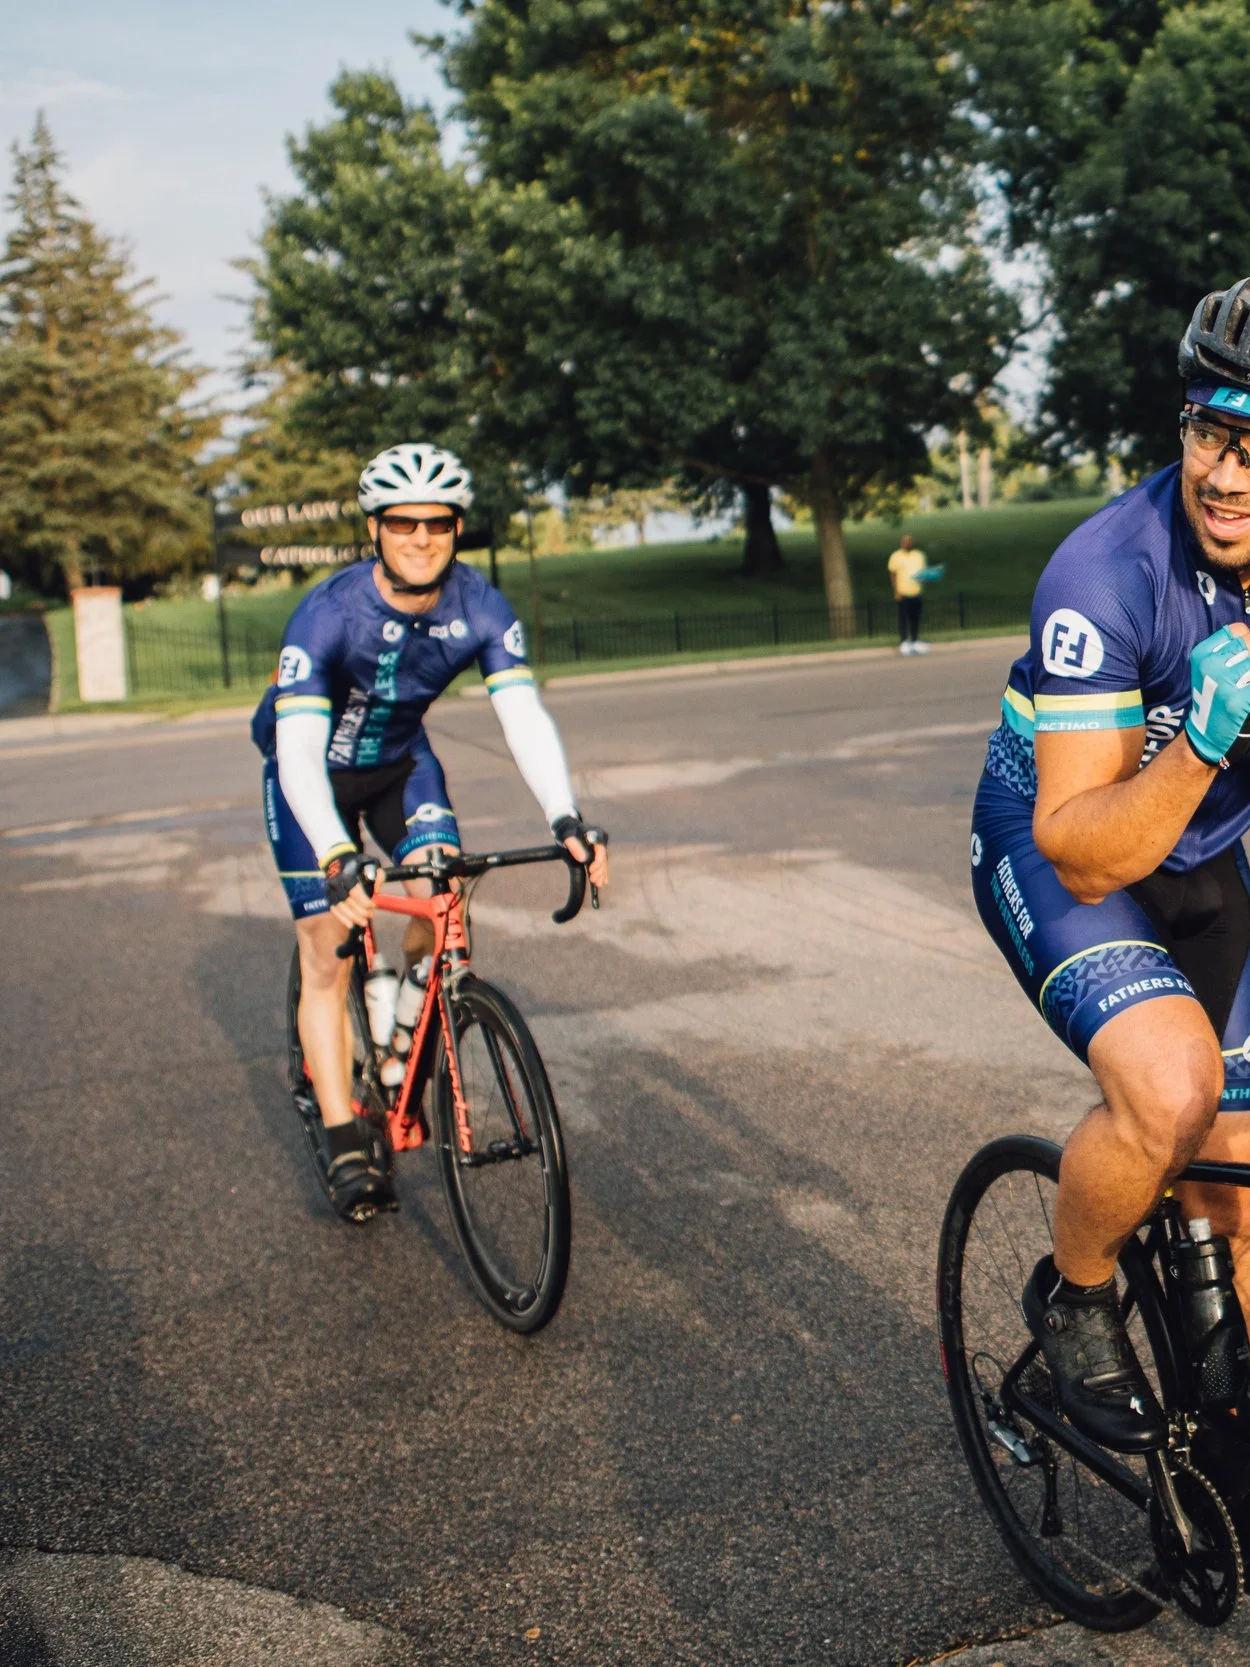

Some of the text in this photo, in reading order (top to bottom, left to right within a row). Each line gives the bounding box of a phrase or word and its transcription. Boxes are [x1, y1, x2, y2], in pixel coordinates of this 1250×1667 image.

[241, 504, 287, 529] OUR
[287, 501, 339, 523] LADY
[260, 545, 358, 566] CATHOLIC
[1038, 721, 1100, 732] PACTIMO
[996, 855, 1034, 941] FATHERS FOR
[990, 871, 1035, 977] THE FATHERLESS
[1097, 977, 1196, 1013] FATHERS FO
